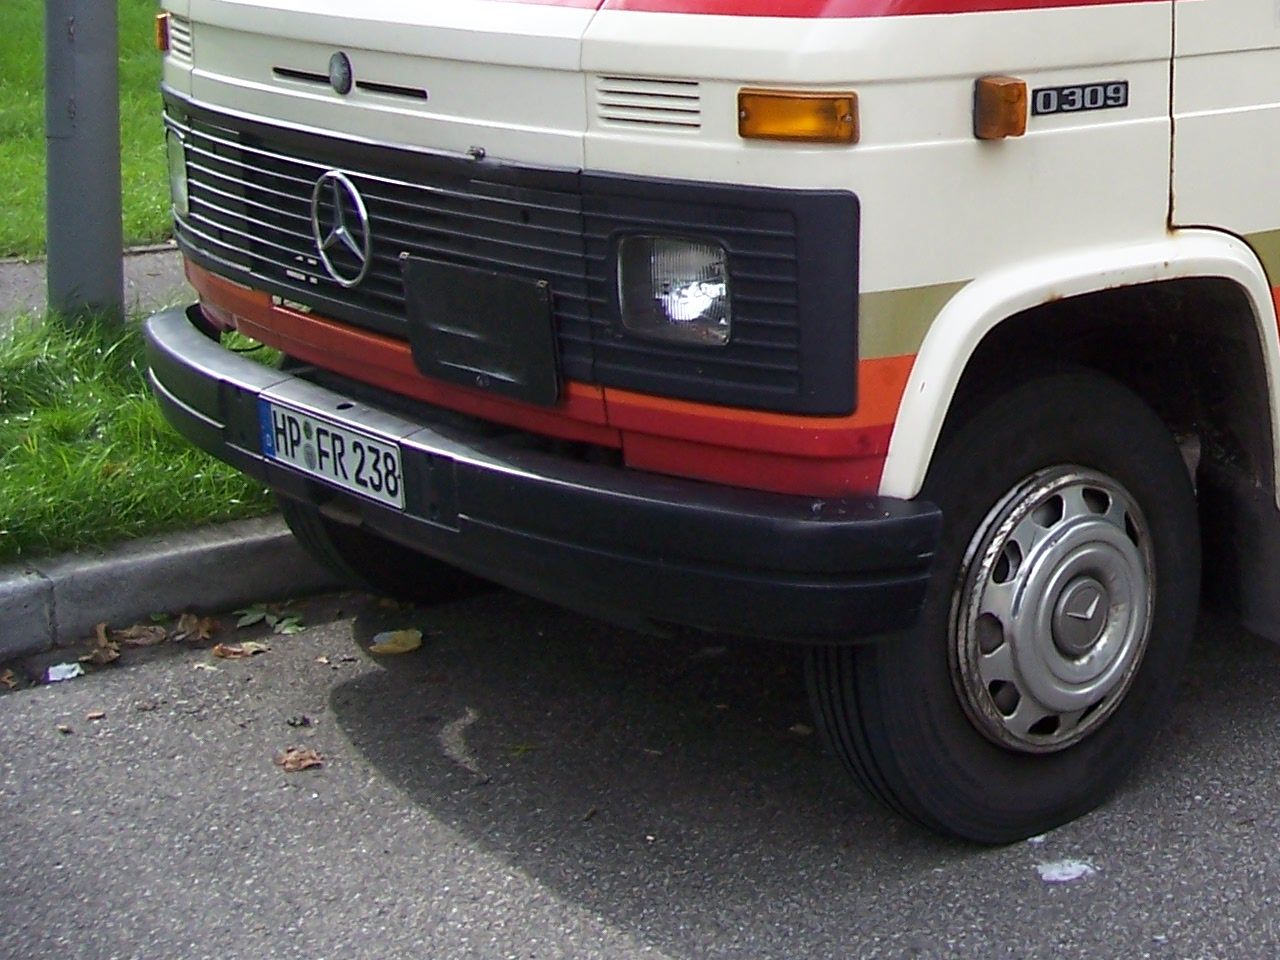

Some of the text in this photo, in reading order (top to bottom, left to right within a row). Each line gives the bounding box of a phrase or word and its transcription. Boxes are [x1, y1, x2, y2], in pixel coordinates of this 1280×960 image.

[273, 410, 398, 497] HP FR 238
